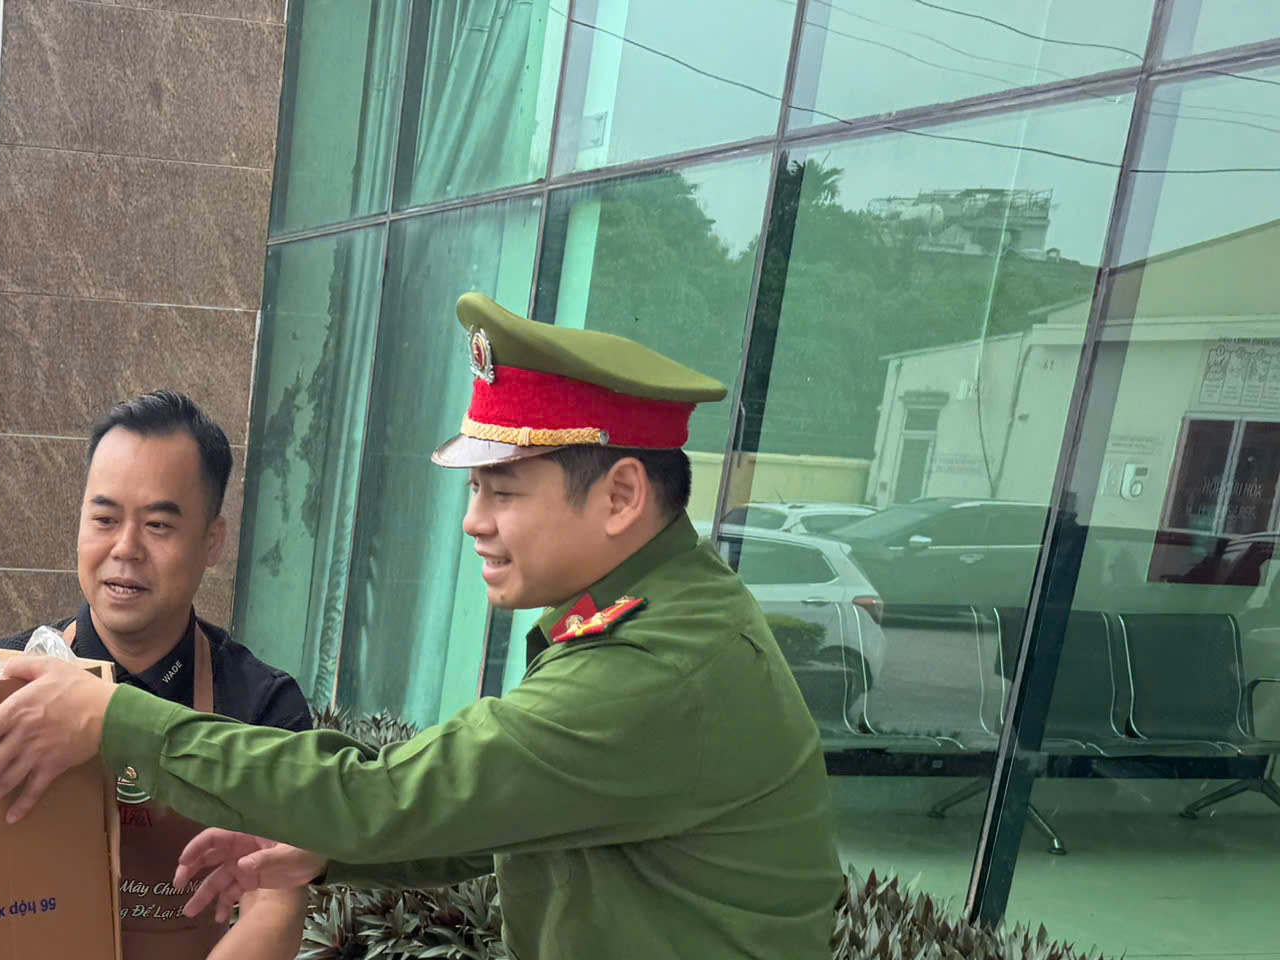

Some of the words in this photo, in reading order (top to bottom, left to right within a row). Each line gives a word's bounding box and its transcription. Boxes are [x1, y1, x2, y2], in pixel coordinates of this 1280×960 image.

[162, 659, 183, 684] WADE
[9, 900, 36, 916] hộp
[40, 898, 56, 911] 56
